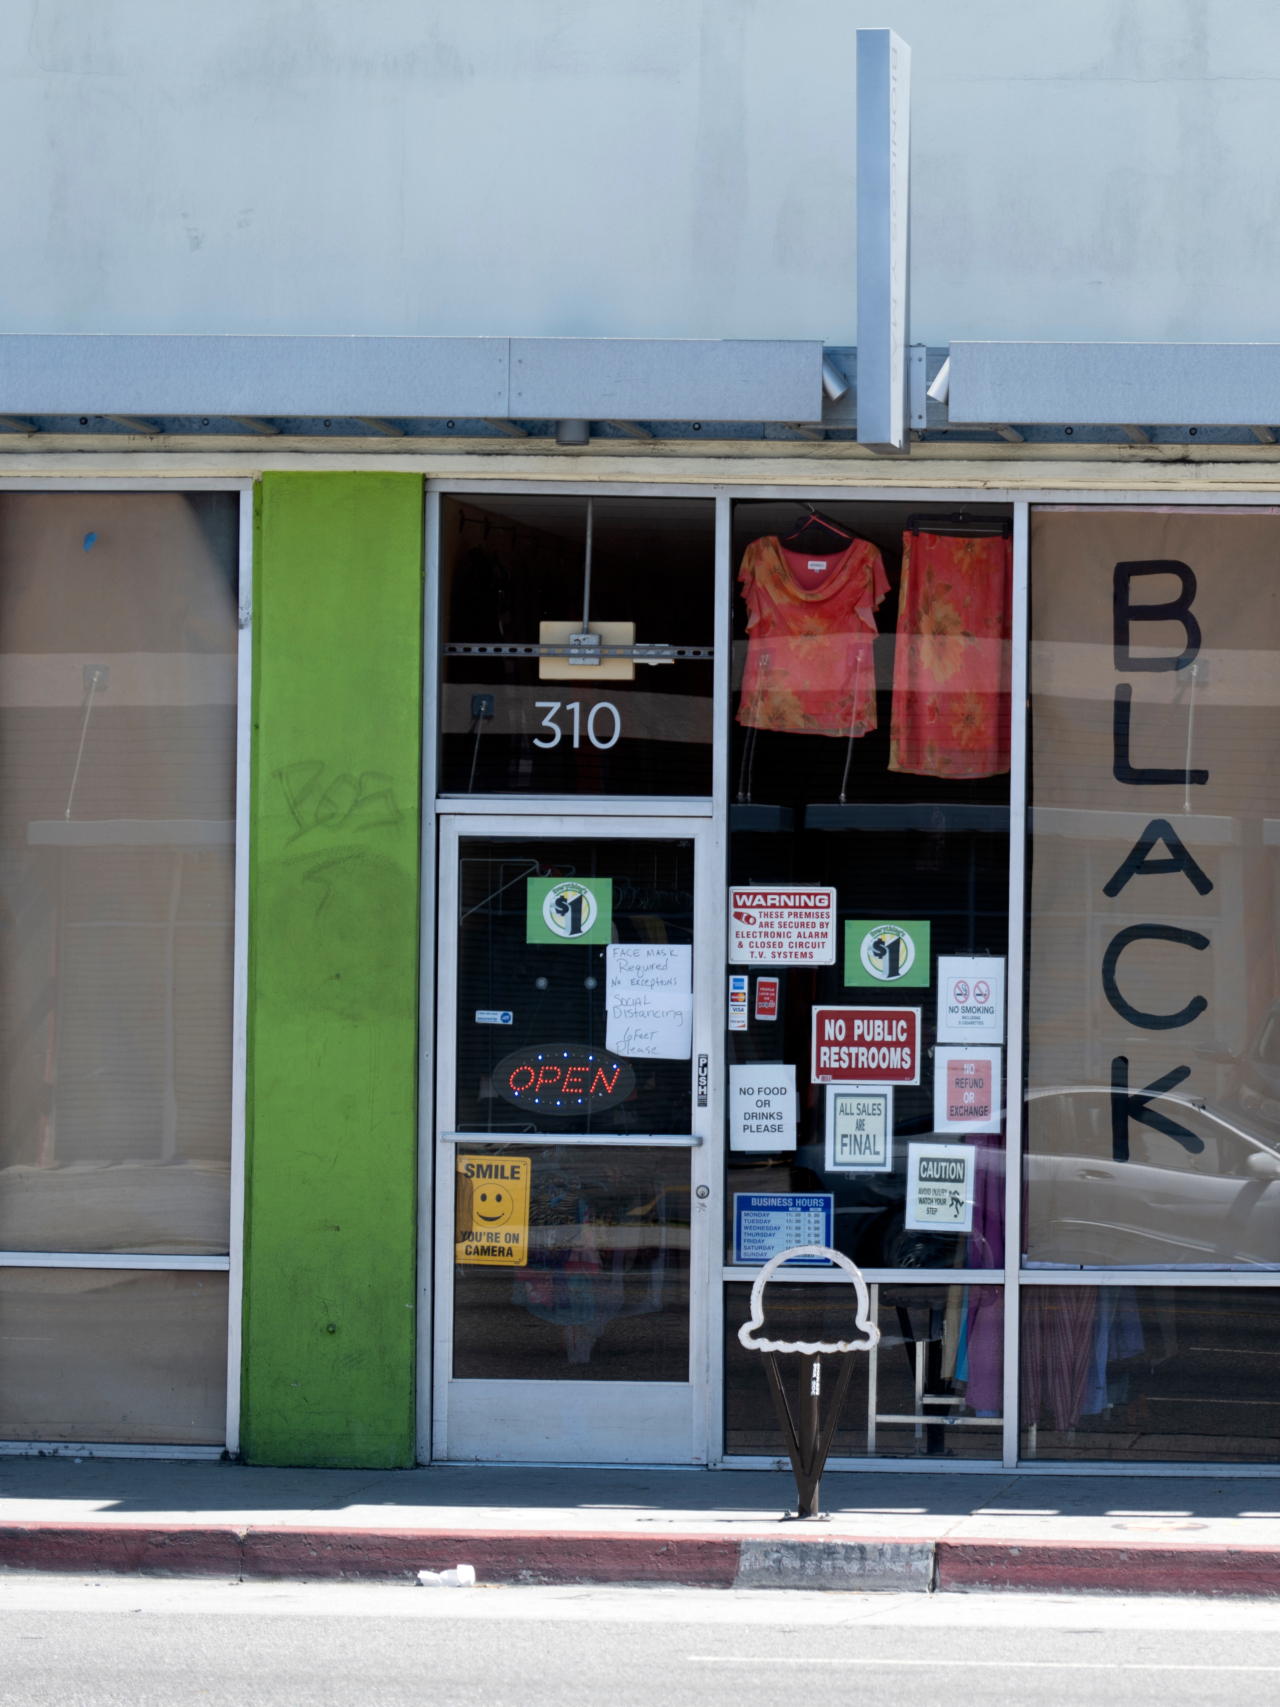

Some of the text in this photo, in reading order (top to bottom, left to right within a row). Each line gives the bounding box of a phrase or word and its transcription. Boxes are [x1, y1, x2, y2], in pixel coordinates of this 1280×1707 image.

[533, 702, 621, 749] 310
[1102, 559, 1214, 1162] BLACK
[735, 894, 829, 907] WARNING
[758, 911, 830, 919] THESE PREMISES
[758, 921, 774, 929] ARE
[778, 921, 816, 929] SECURED
[735, 931, 828, 939] ELECTRONIC ALARM
[737, 941, 826, 949] & CLOSED CIRCUIT
[613, 948, 678, 958] FACE MASK
[750, 951, 814, 959] T.V. SYSTEMS
[616, 958, 668, 978] Required
[949, 1006, 994, 1014] NO SMOKING
[612, 1006, 683, 1027] Distancing
[824, 1019, 907, 1042] NO PUBLIC
[616, 1041, 660, 1055] Please
[820, 1046, 911, 1070] RESTROOMS
[964, 1063, 975, 1075] NO
[509, 1065, 620, 1094] OPEN
[698, 1057, 708, 1095] PUSH
[955, 1078, 984, 1089] REFUND
[739, 1087, 787, 1096] NO FOOD
[755, 1099, 771, 1108] OR
[963, 1092, 975, 1104] OR
[839, 1102, 882, 1116] ALL SALES
[949, 1105, 989, 1117] EXCHANGE
[743, 1111, 783, 1121] DRINKS
[743, 1124, 784, 1133] PLEASE
[855, 1118, 866, 1131] ARE
[840, 1133, 880, 1156] FINAL
[465, 1163, 521, 1180] SMILE
[920, 1161, 964, 1180] CAUTION
[918, 1187, 948, 1197] AVOID INJURY
[751, 1197, 824, 1207] BUSINESS HOURS
[918, 1197, 947, 1206] WATCH YOUR
[926, 1206, 938, 1215] STEP
[461, 1231, 520, 1244] YOU'RE ON
[465, 1244, 514, 1257] CAMERA
